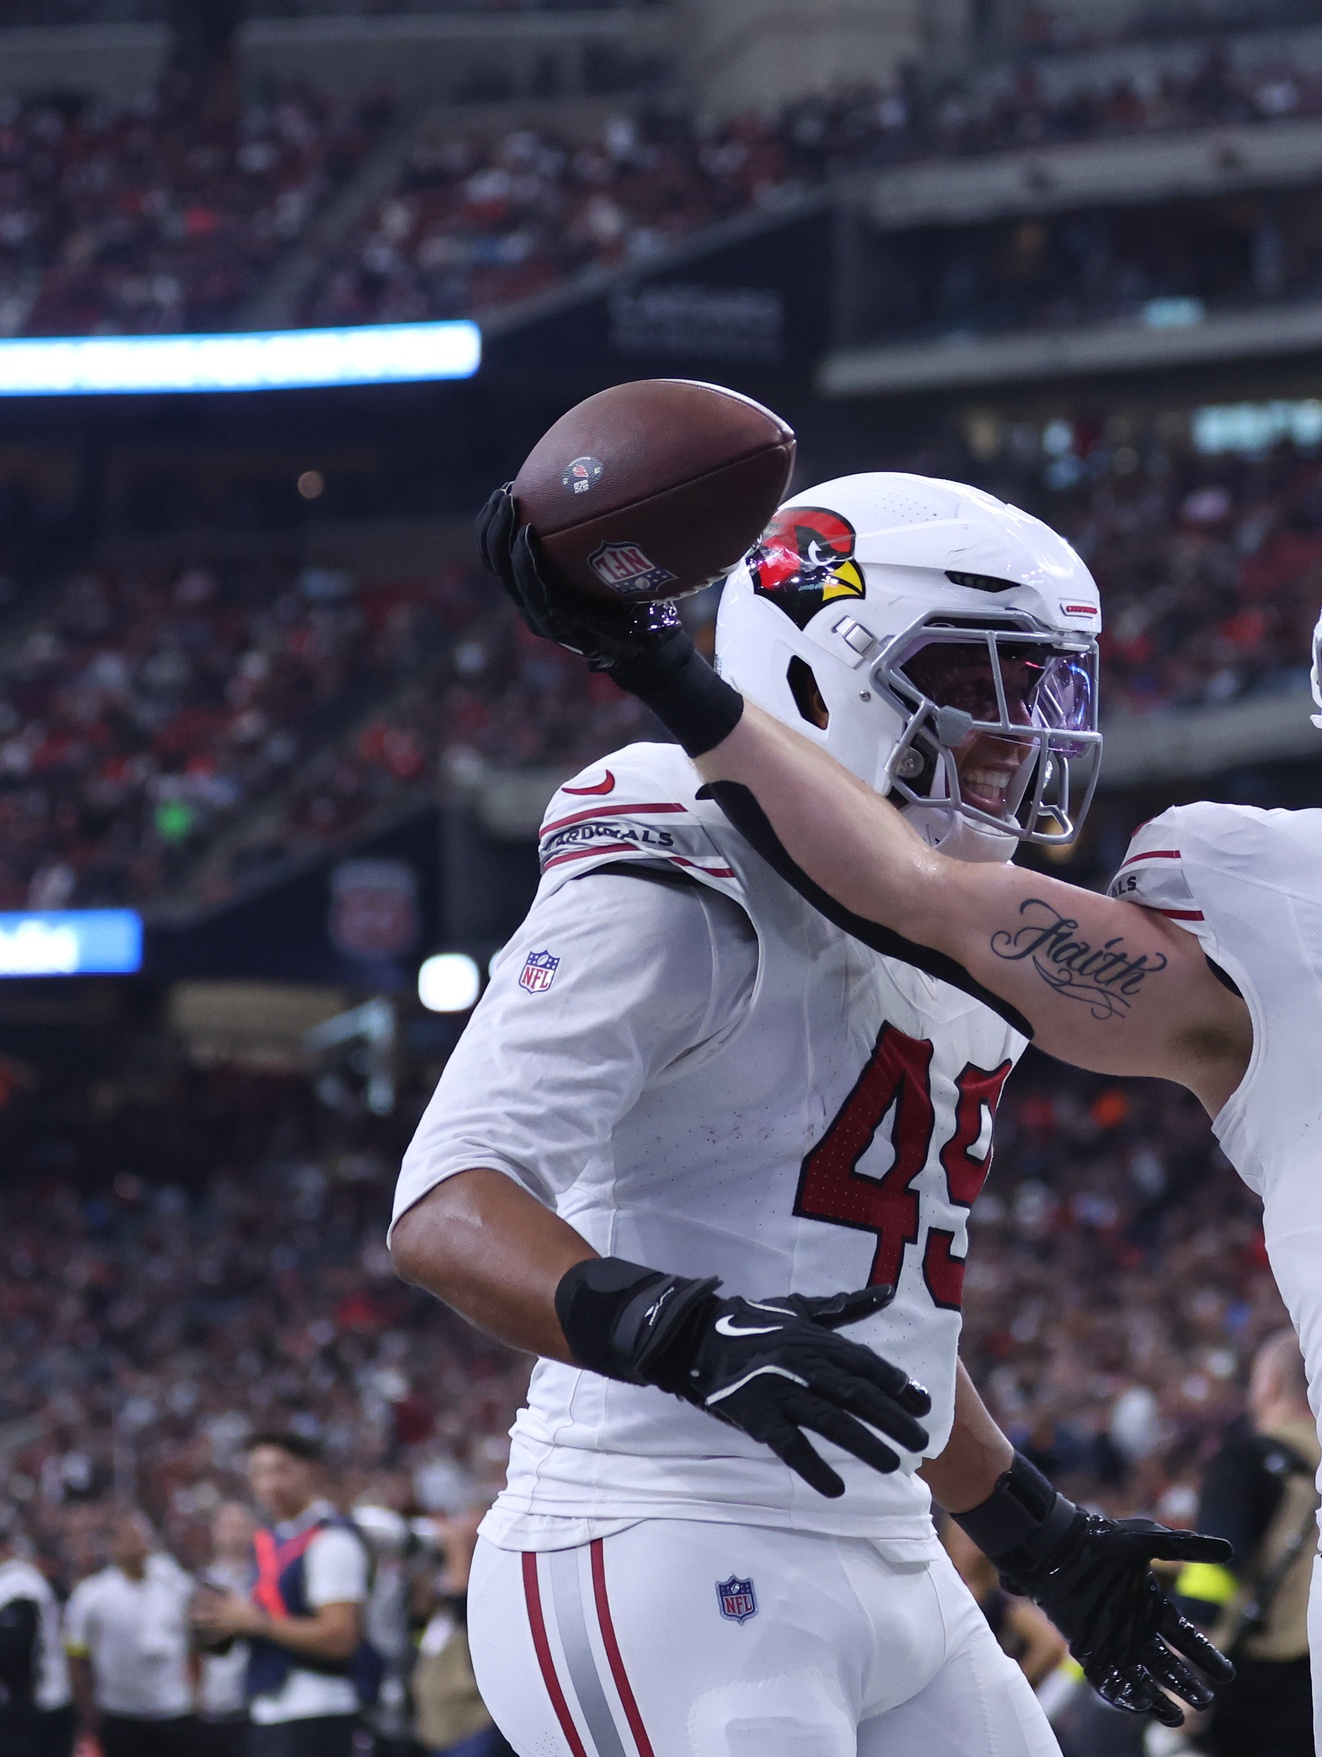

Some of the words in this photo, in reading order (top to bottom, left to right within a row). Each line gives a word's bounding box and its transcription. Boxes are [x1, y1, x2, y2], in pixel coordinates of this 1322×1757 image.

[594, 549, 653, 580] NFL
[991, 898, 1167, 1005] Faith
[522, 967, 549, 989] NFL
[725, 1596, 752, 1615] NFL
